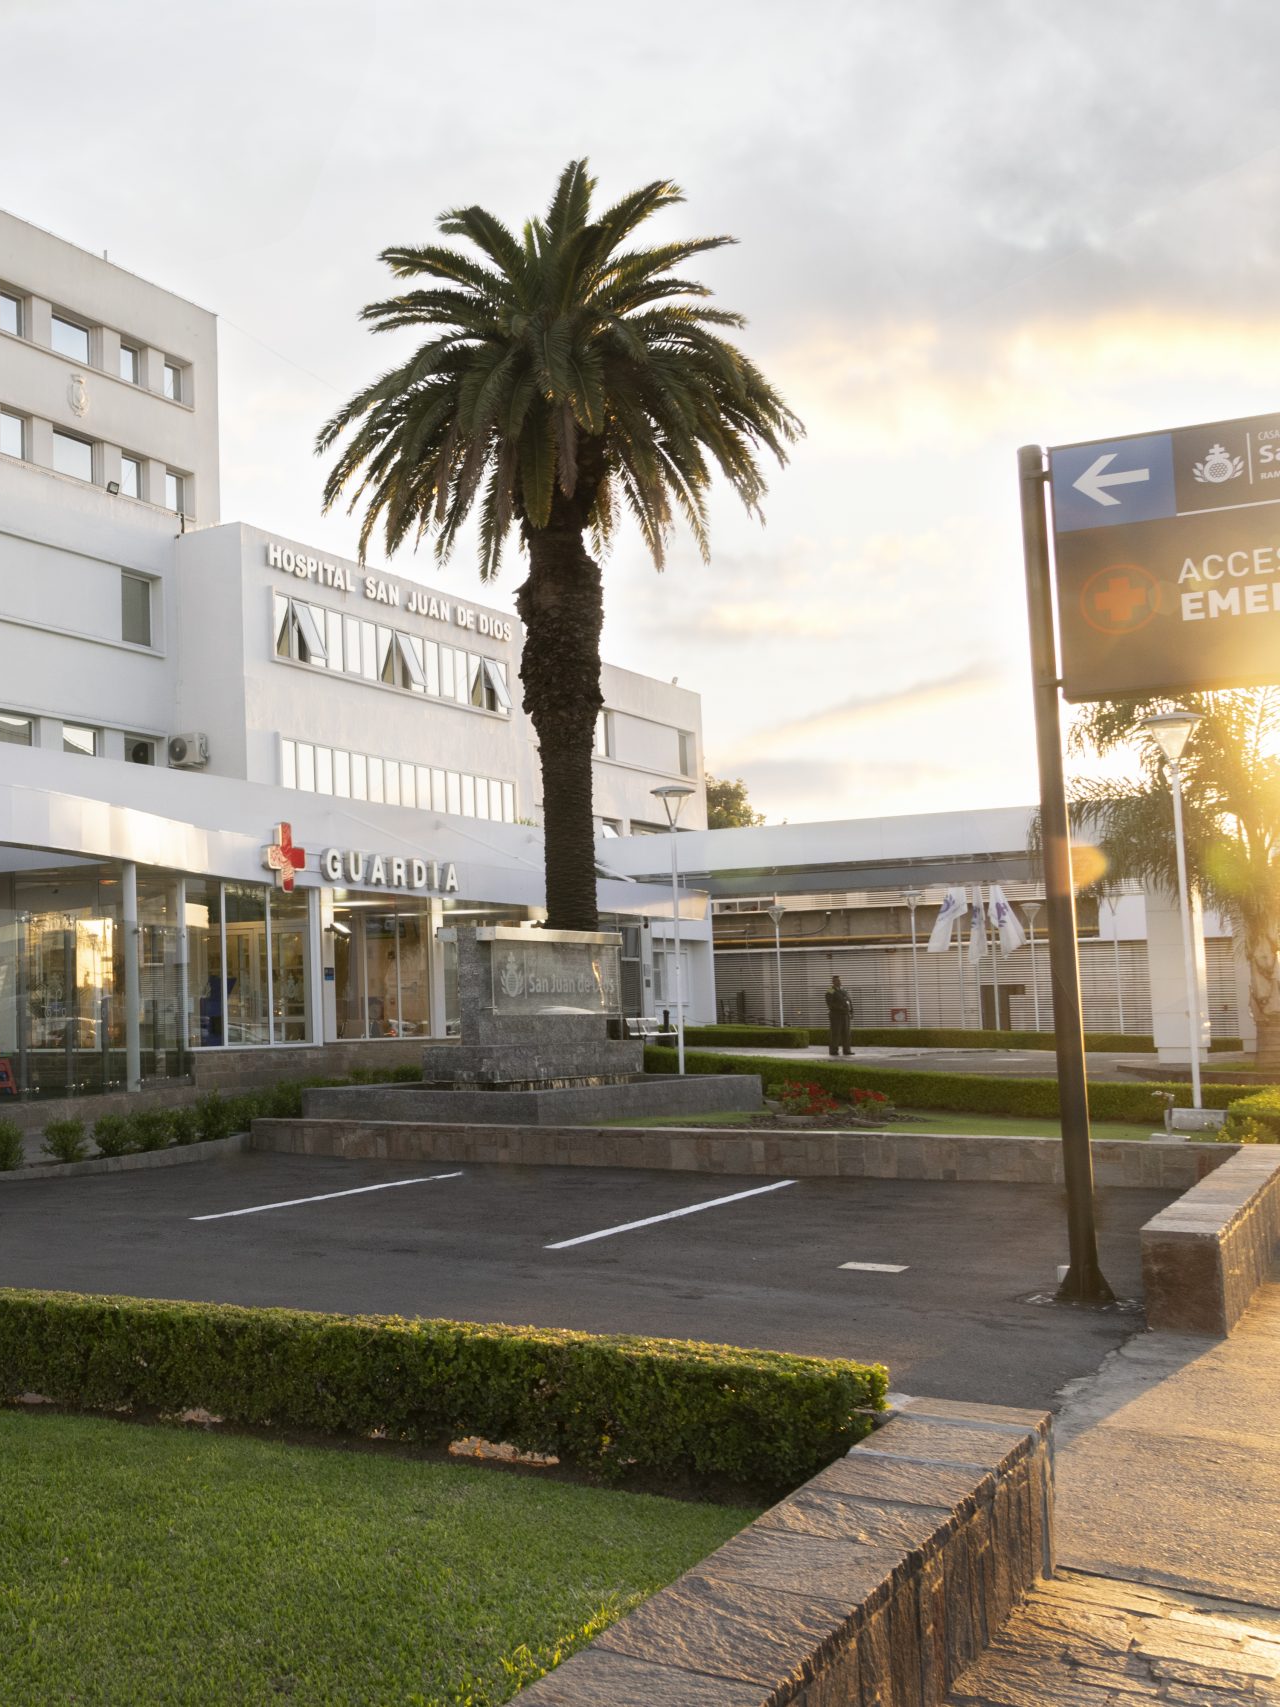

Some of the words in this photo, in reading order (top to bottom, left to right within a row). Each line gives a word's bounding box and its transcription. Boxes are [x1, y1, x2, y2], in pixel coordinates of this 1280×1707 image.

[1177, 547, 1280, 584] ACCE
[268, 542, 356, 593] HOSPITAL
[365, 576, 400, 607] SAN
[407, 591, 450, 622] JUAN
[456, 605, 476, 630] DE
[478, 613, 512, 642] DIOS
[322, 847, 459, 892] GUARDIA
[528, 973, 549, 993] San
[551, 973, 575, 993] Juan
[577, 972, 590, 993] de
